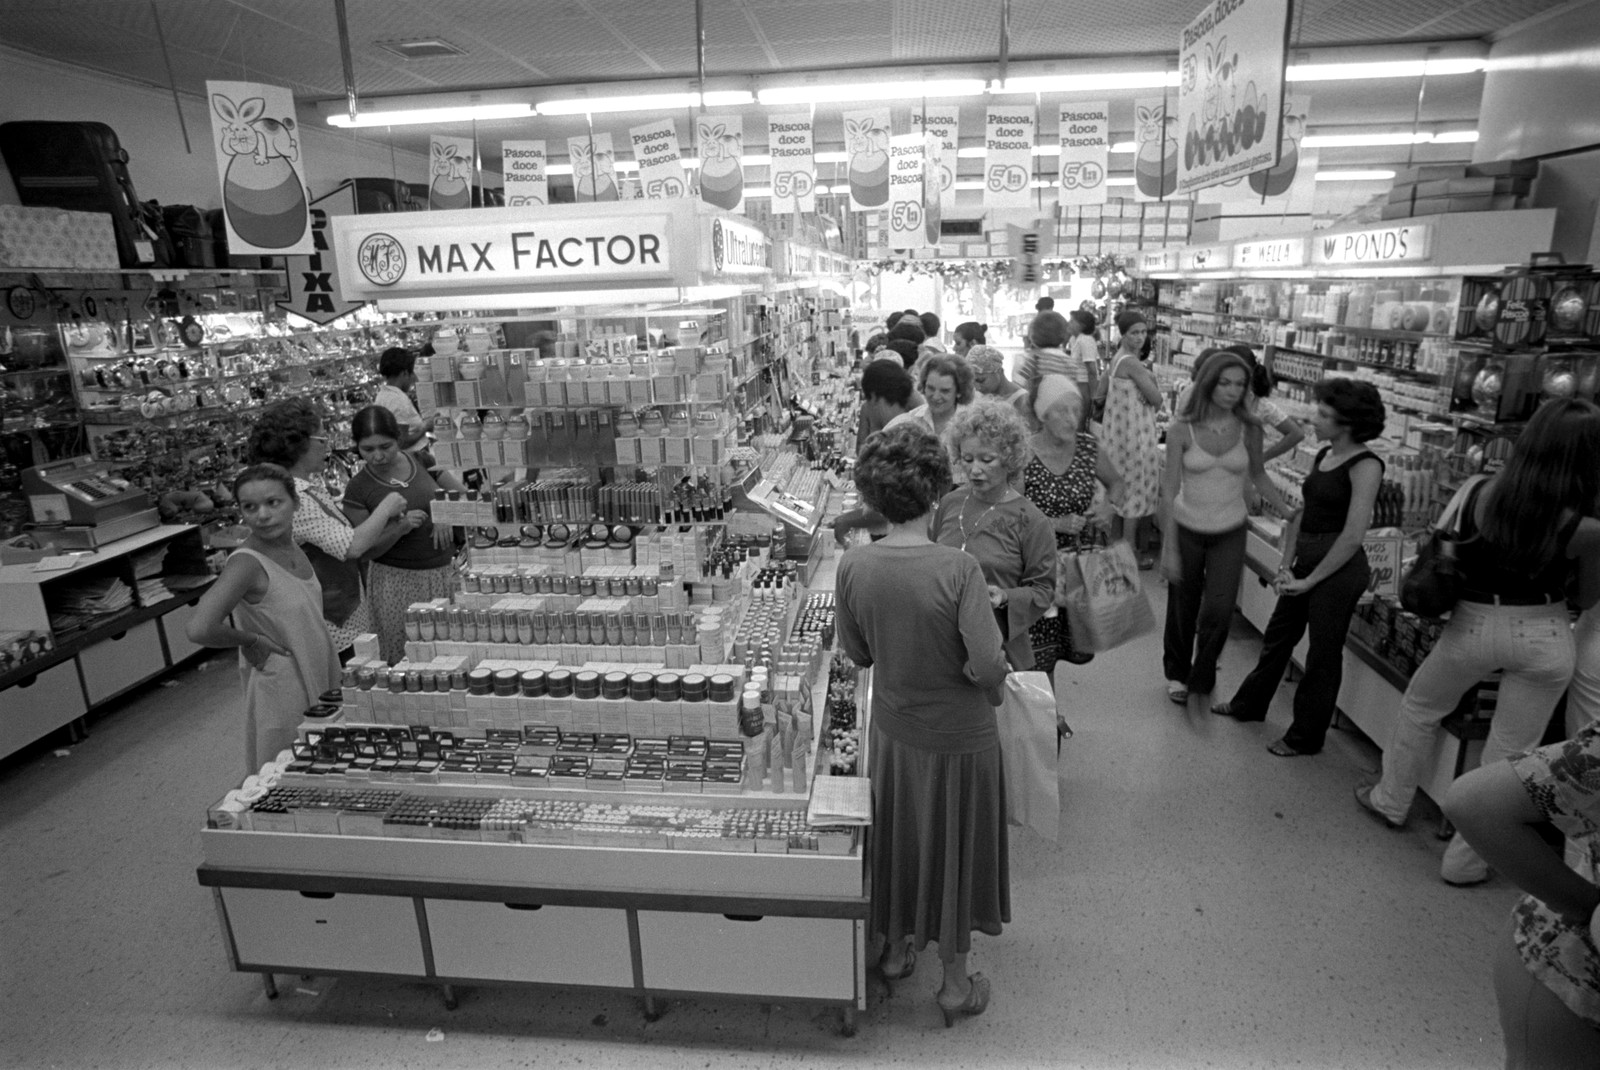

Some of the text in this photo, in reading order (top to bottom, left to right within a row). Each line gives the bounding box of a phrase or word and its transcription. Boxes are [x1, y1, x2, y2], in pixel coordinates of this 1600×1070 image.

[995, 125, 1024, 138] doce
[1069, 122, 1098, 135] doce
[778, 135, 806, 144] doce
[643, 141, 669, 155] doce
[512, 160, 537, 171] doce
[897, 159, 919, 170] doce
[417, 231, 661, 274] MAX FACTOR
[1259, 243, 1290, 262] WELLA
